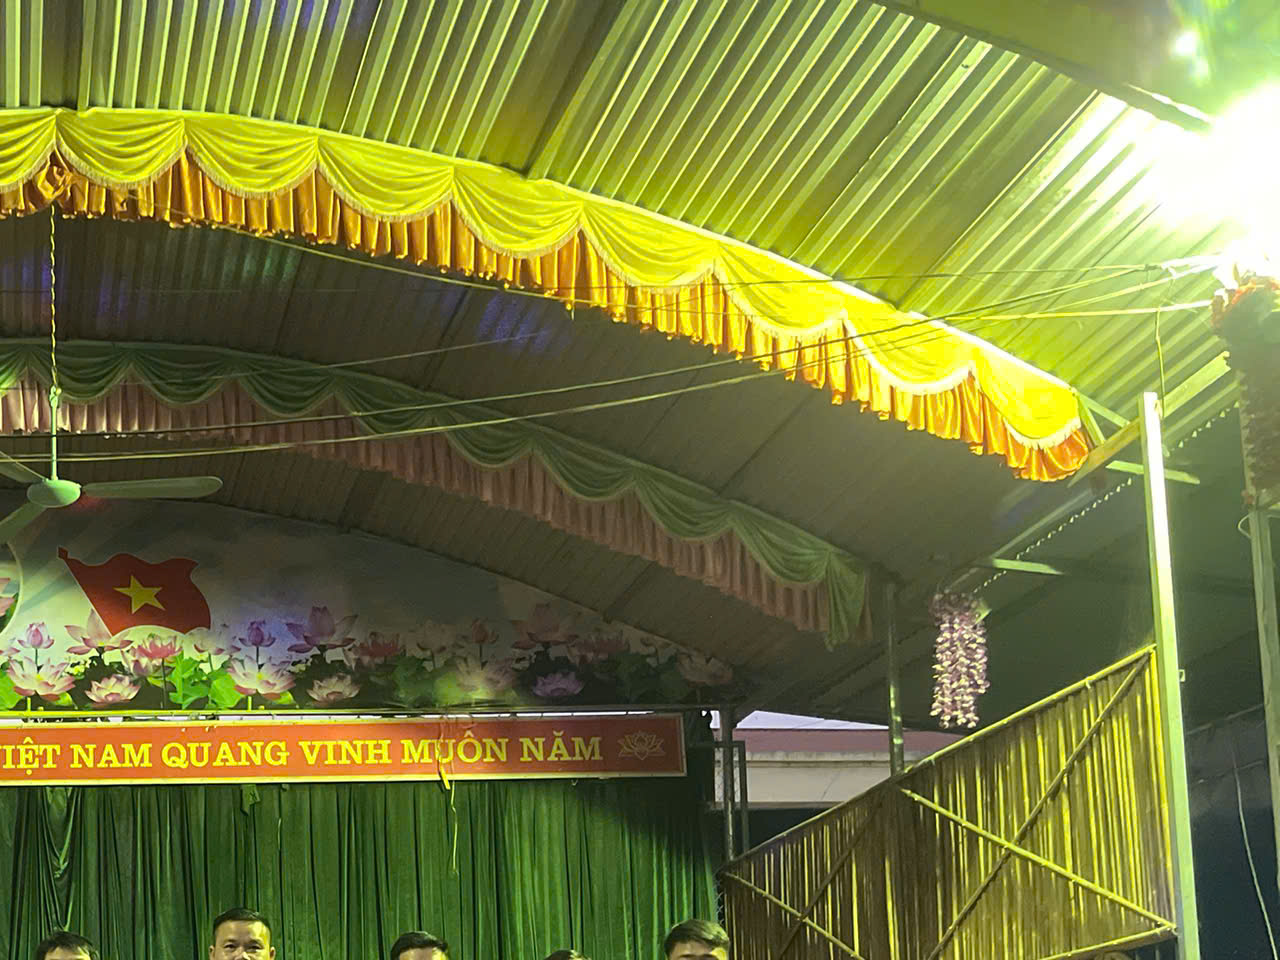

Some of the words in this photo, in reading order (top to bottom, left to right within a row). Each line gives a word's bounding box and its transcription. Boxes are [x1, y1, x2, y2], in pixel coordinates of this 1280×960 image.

[70, 743, 153, 769] NAM
[161, 740, 289, 769] QUANG
[301, 739, 392, 766] VINH
[399, 731, 510, 765] MUÔN
[518, 731, 602, 762] NĂM
